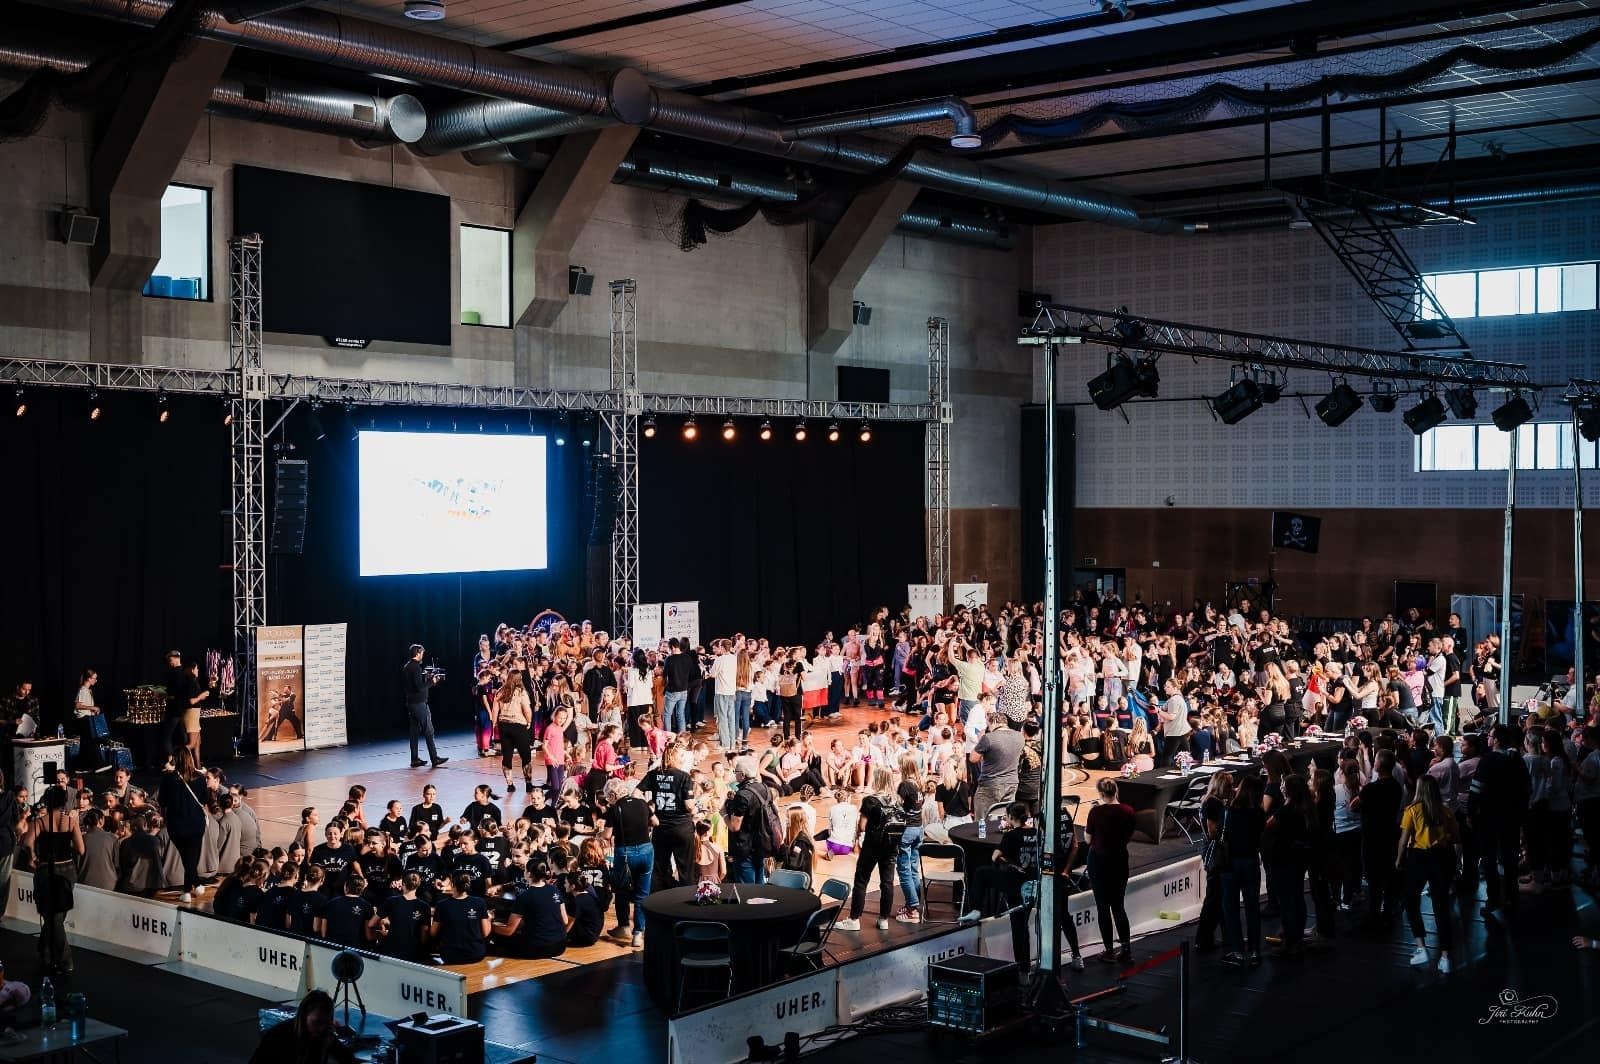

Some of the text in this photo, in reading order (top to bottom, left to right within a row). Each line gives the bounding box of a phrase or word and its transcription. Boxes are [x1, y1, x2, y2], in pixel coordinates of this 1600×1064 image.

[1164, 876, 1193, 897] UHER.
[132, 913, 173, 937] UHER.
[259, 946, 301, 970] UHER.
[401, 982, 452, 1012] UHER.
[776, 991, 826, 1019] UHER.
